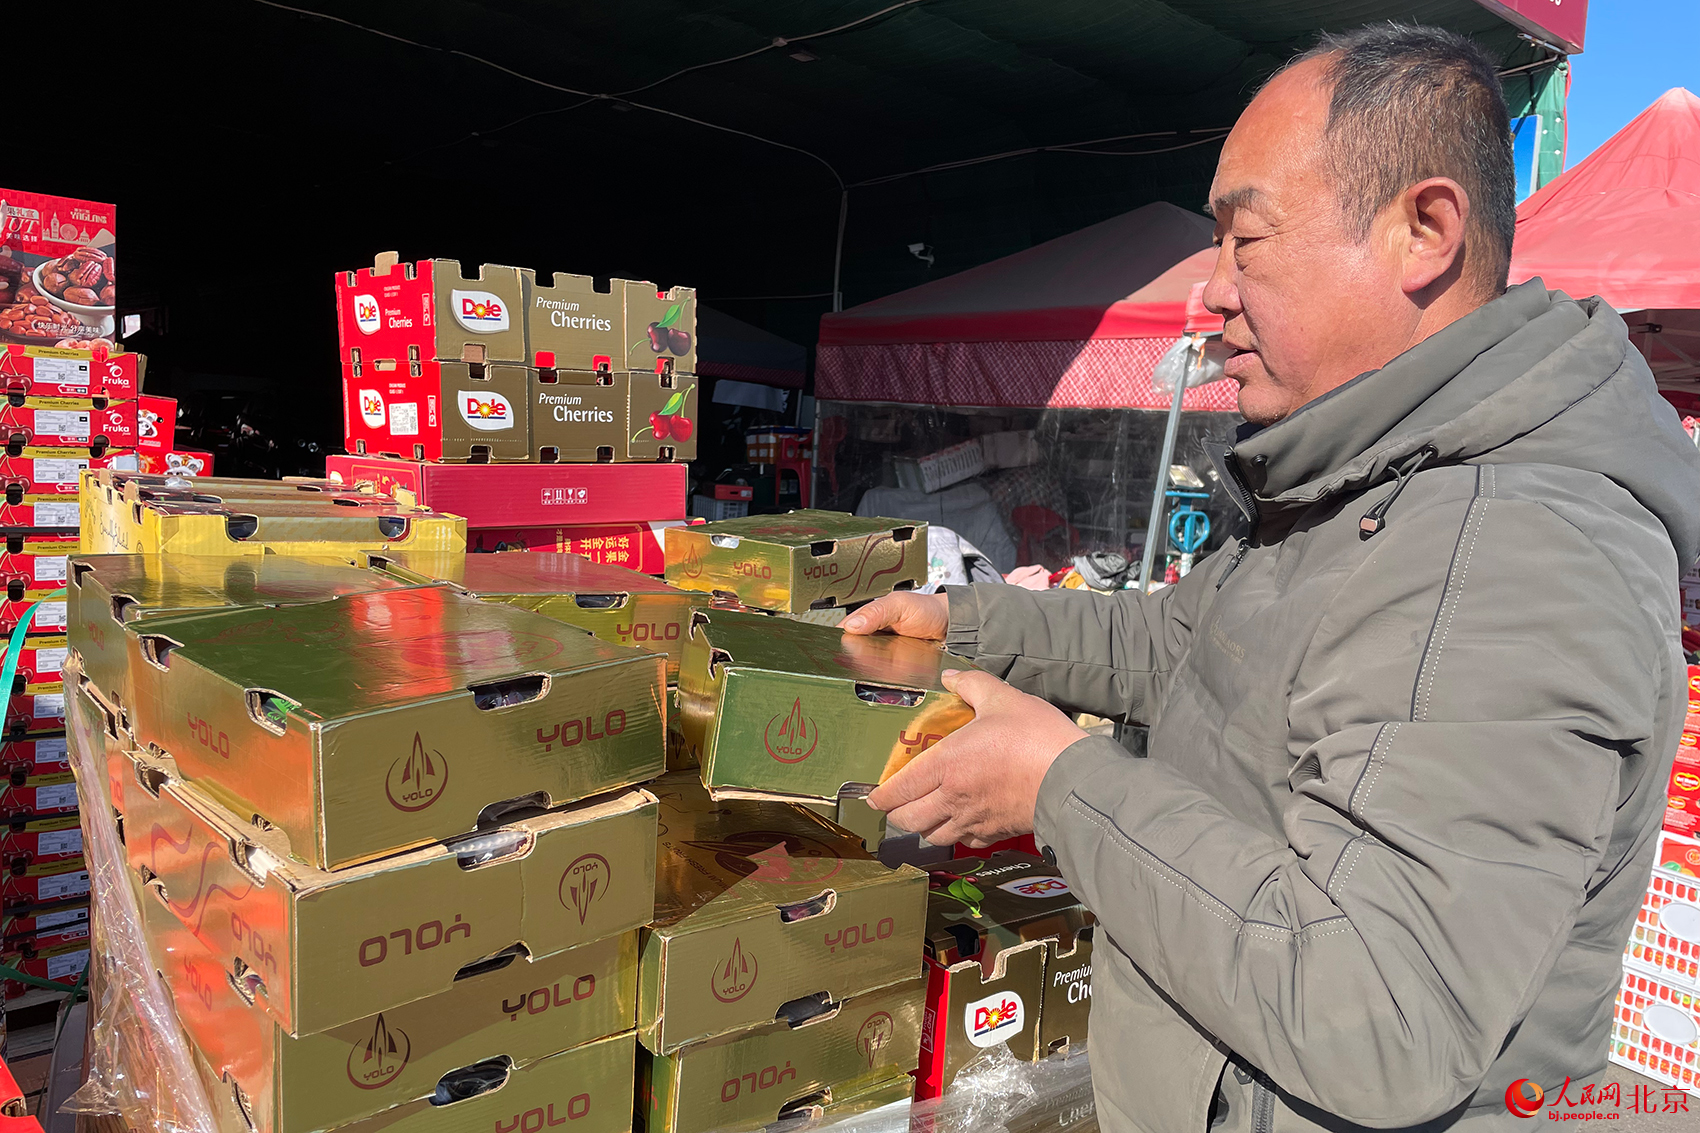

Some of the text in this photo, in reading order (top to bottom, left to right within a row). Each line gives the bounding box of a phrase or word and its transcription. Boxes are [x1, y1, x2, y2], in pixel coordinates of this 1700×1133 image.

[359, 302, 377, 319] Dole
[384, 308, 401, 316] Premium
[462, 298, 502, 319] Dole
[536, 296, 580, 311] Premium
[388, 316, 413, 328] Cherries
[550, 310, 612, 331] Cherries
[102, 376, 130, 385] Fruka
[363, 396, 382, 414] Dole
[538, 392, 582, 405] Premium
[467, 398, 506, 418] Dole
[553, 405, 614, 423] Cherries
[103, 424, 130, 433] Fruka
[580, 536, 630, 549] 好运全开
[733, 561, 772, 579] YOLO
[803, 562, 838, 580] YOLO
[617, 622, 680, 642] YOLO
[187, 712, 229, 759] YOLO
[536, 709, 626, 752] YOLO
[776, 746, 802, 755] YOLO
[402, 787, 433, 802] YOLO
[573, 862, 598, 875] YOLO
[975, 862, 1031, 877] Cherries
[1019, 880, 1068, 895] Dole
[231, 912, 277, 974] YOLO
[358, 913, 471, 968] YOLO
[824, 917, 894, 953] YOLO
[183, 955, 212, 1012] YOLO
[1053, 963, 1092, 987] Premiu
[501, 974, 596, 1022] YOLO
[722, 983, 746, 996] YOLO
[974, 998, 1018, 1032] Dole
[363, 1065, 395, 1081] YOLO
[721, 1060, 796, 1103] YOLO
[495, 1093, 591, 1133] YOLO
